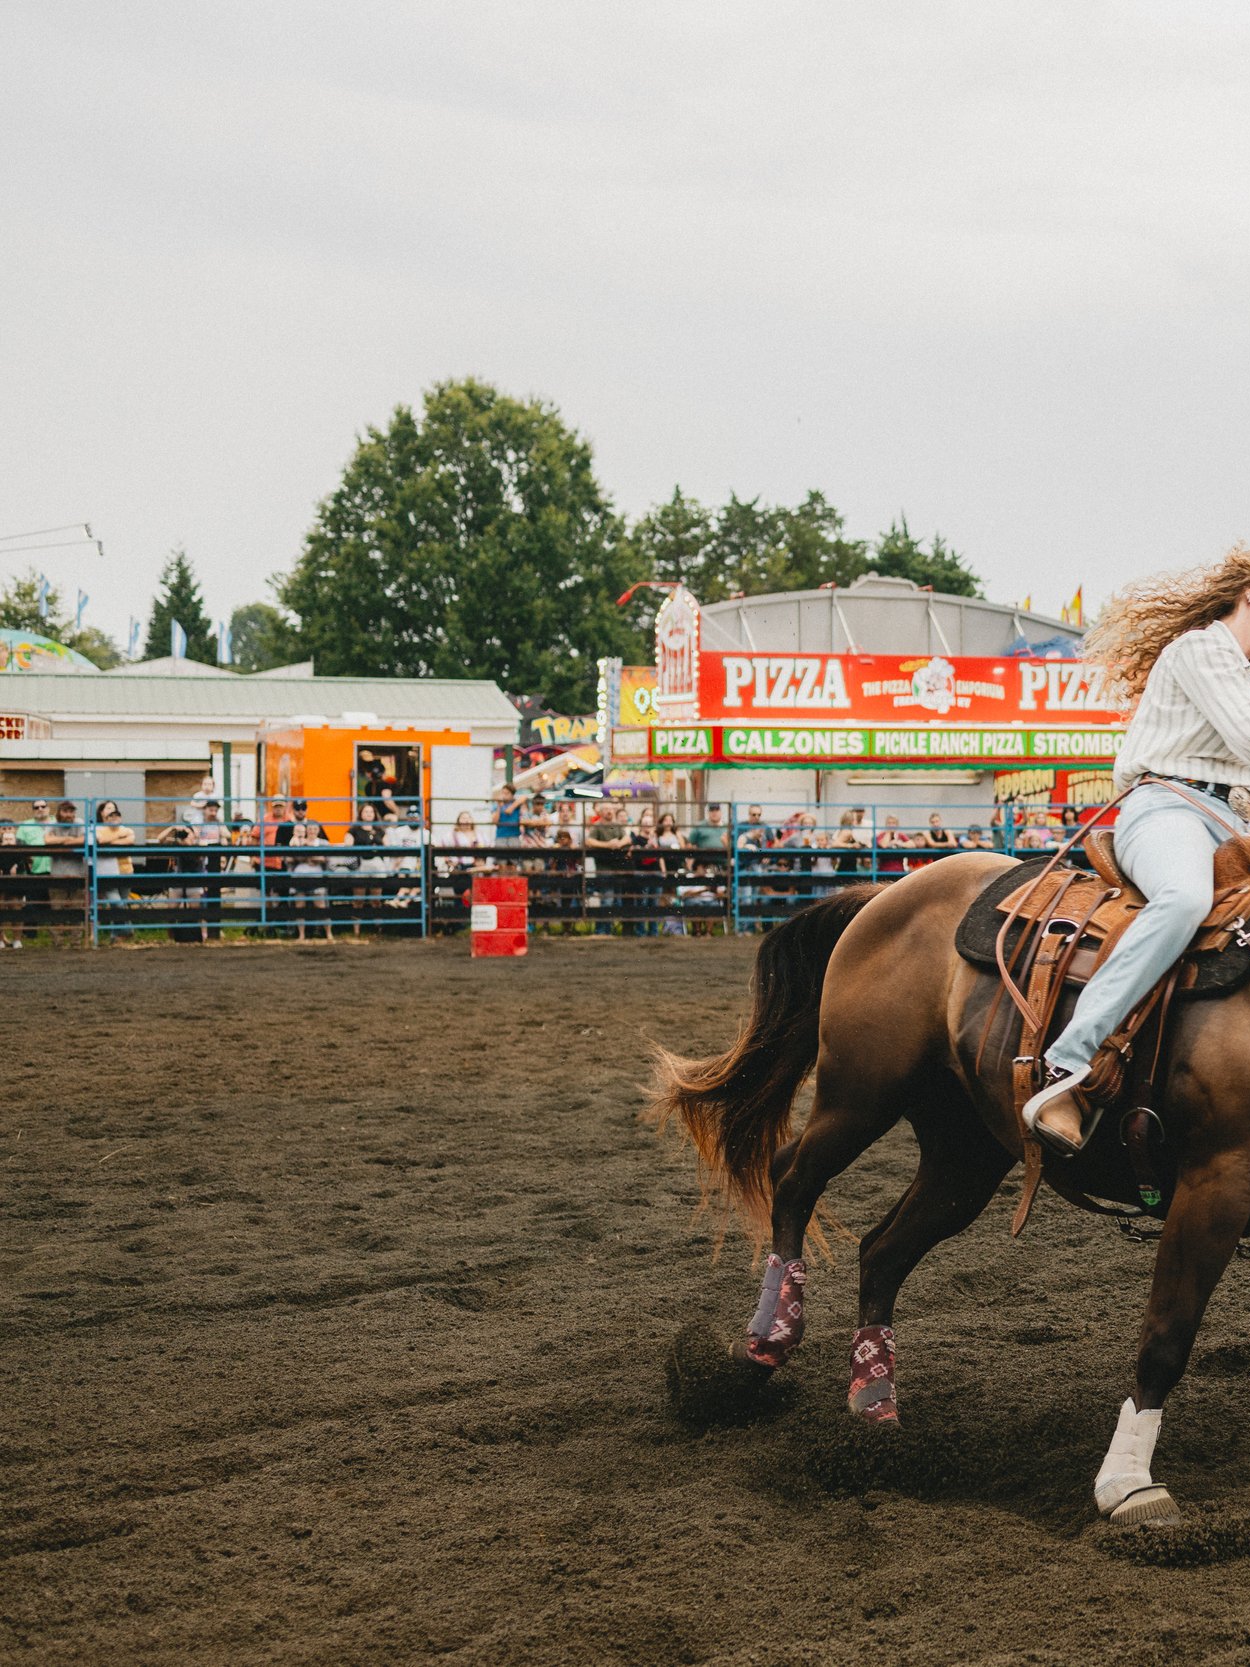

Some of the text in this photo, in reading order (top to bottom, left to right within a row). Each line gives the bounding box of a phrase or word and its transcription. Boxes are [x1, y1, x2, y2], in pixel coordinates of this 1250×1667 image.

[722, 656, 851, 708] PIZZA
[882, 679, 911, 695] PIZZA
[597, 659, 607, 743] TACOS
[655, 730, 709, 754] PIZZA
[728, 730, 866, 755] CALZONES
[875, 731, 1024, 756] PICKLE RANCH PIZZA
